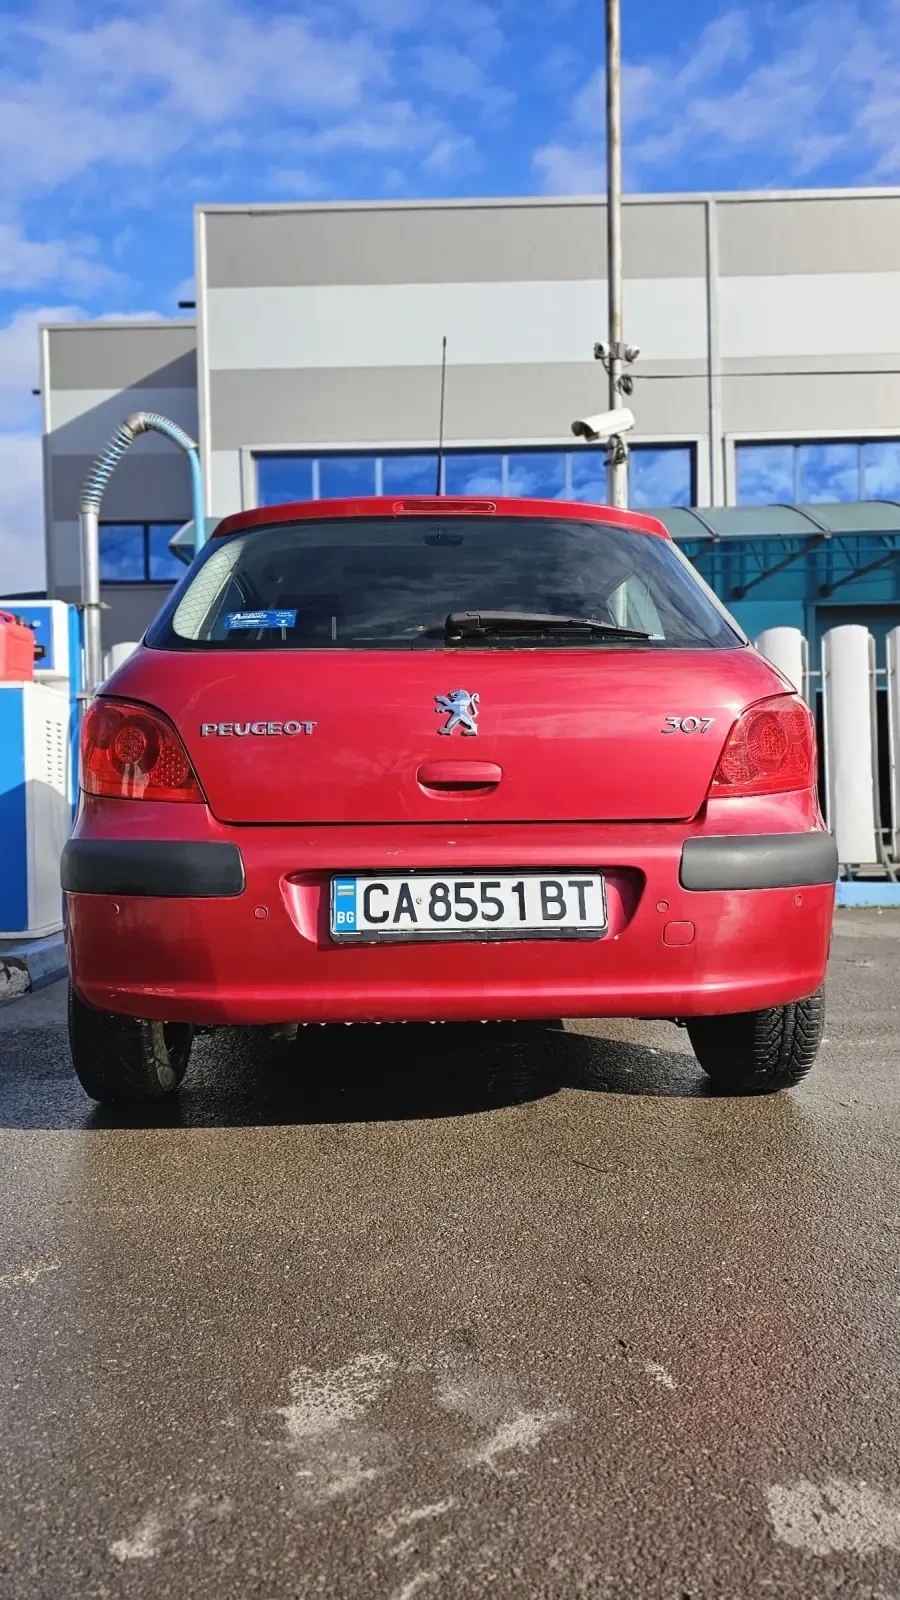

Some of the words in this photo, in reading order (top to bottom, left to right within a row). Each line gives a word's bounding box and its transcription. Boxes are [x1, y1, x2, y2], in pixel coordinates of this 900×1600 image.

[200, 720, 317, 737] PEUGEOT
[660, 716, 716, 734] 307
[363, 882, 418, 924] CA
[428, 881, 527, 923] 8551
[539, 880, 594, 921] BT
[336, 911, 355, 924] BG
